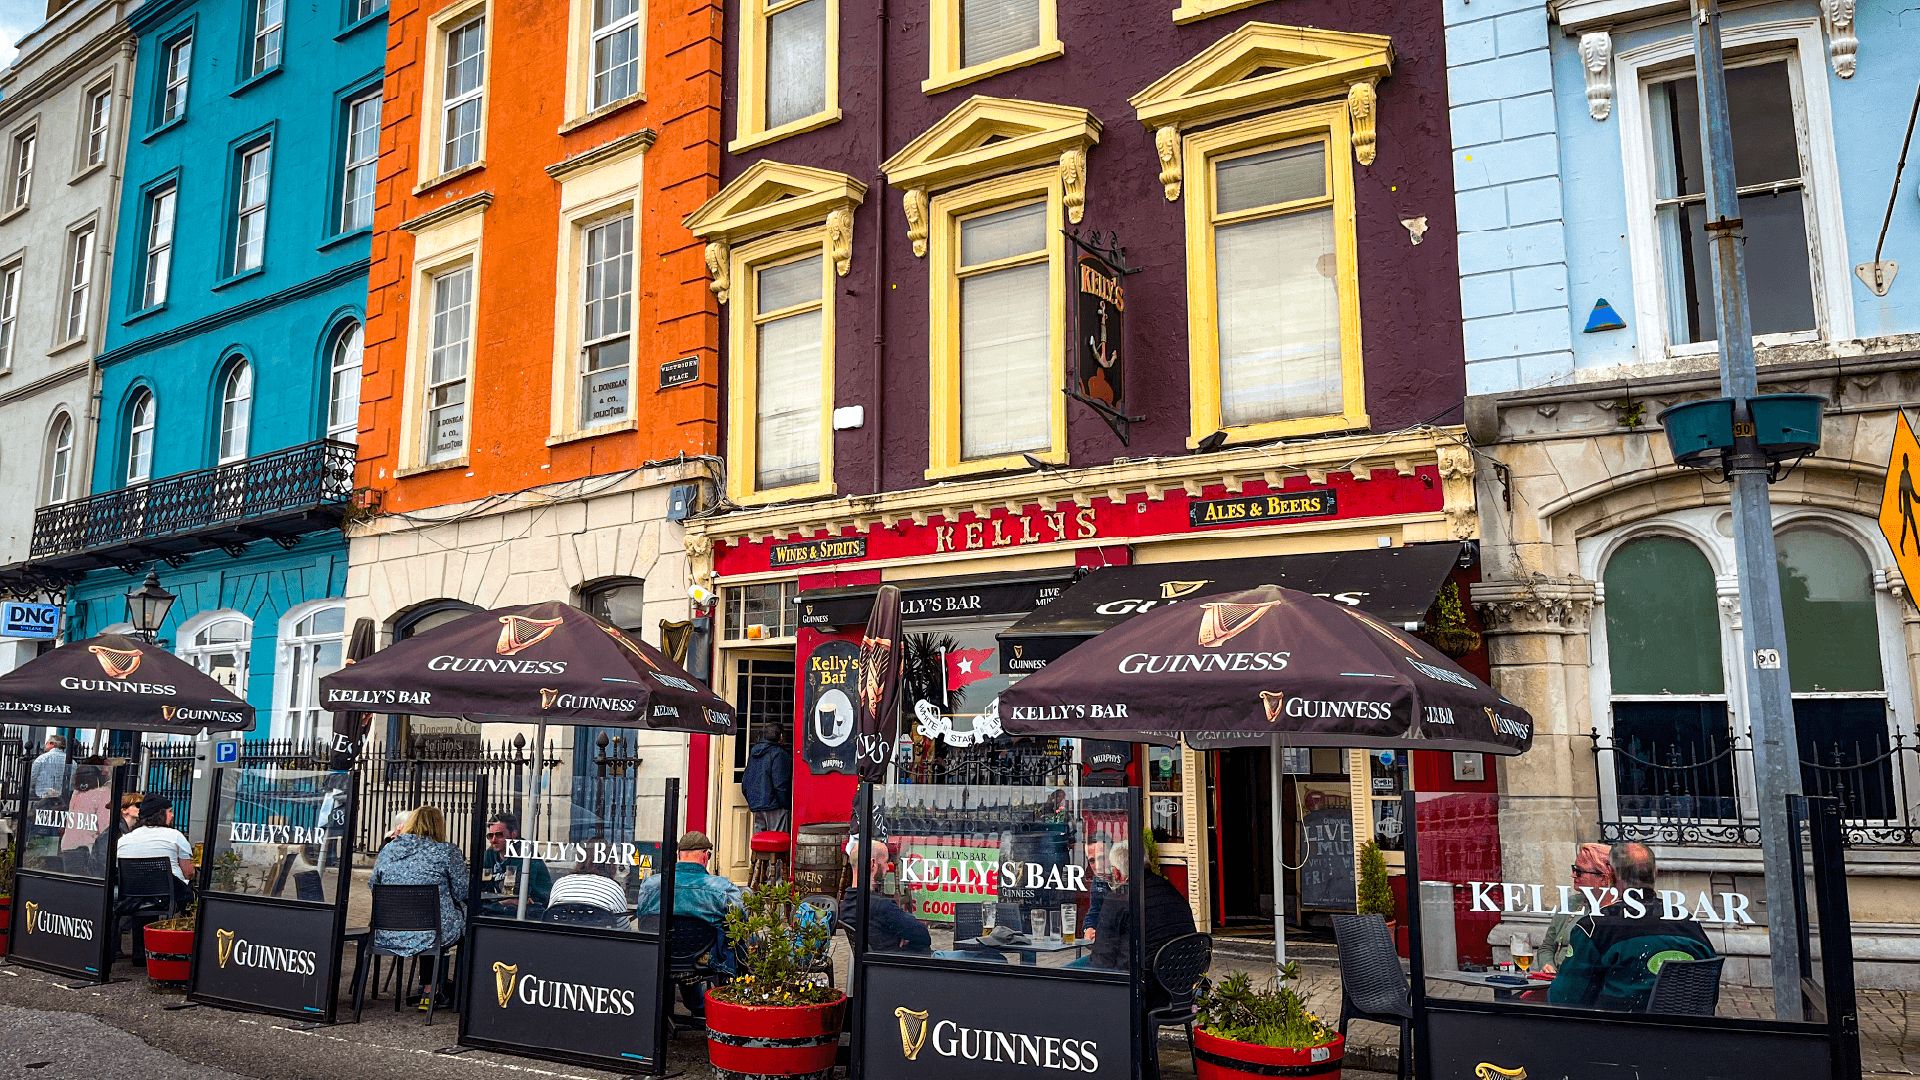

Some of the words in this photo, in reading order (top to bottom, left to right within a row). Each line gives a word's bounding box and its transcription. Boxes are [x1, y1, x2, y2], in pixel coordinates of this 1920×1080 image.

[1081, 263, 1124, 311] KELLY'S
[598, 379, 627, 392] DONEGAN
[668, 373, 689, 382] PLACE
[593, 406, 624, 419] SOLICITORS
[1736, 424, 1750, 435] 90
[1204, 504, 1246, 521] ALES
[1249, 504, 1263, 517] &
[1267, 496, 1321, 515] BEERS
[776, 546, 808, 563] WINES
[809, 547, 817, 559] &
[820, 540, 860, 557] SPIRITS
[1039, 587, 1060, 597] LIVE
[901, 598, 942, 614] LLY'S
[946, 595, 981, 611] BAR
[10, 606, 54, 624] DNG
[802, 613, 828, 623] GUINNESS
[427, 655, 568, 675] GUINNESS
[812, 656, 859, 676] Kelly's
[1009, 658, 1047, 670] GUINNESS
[1118, 651, 1291, 674] GUINNESS
[1758, 653, 1776, 664] 90
[60, 677, 177, 696] GUINNESS
[820, 671, 847, 684] Bar
[328, 688, 396, 704] KELLY'S
[398, 691, 432, 706] BAR
[557, 693, 637, 712] GUINNESS
[0, 702, 41, 713] ELLY'S
[44, 704, 71, 714] BAR
[176, 707, 243, 723] GUINNESS
[918, 703, 938, 731] WHITE
[1011, 704, 1085, 720] KELLY'S
[1089, 703, 1129, 718] BAR
[1285, 697, 1392, 720] GUINNESS
[419, 723, 453, 736] Donegan
[455, 723, 463, 734] &
[464, 722, 479, 734] Co.
[989, 716, 1000, 729] LIN
[950, 734, 974, 743] STAR
[221, 744, 234, 760] P
[34, 809, 75, 829] KELLY'S
[76, 812, 98, 831] BAR
[229, 822, 290, 844] KELLY'S
[294, 826, 325, 844] BAR
[1304, 824, 1351, 842] LIVE
[504, 839, 587, 862] KELLY'S
[592, 842, 639, 866] BAR
[936, 850, 969, 861] KELLY'S
[969, 852, 987, 861] BAR
[1316, 841, 1353, 856] MUS
[795, 871, 823, 885] OWERS
[900, 857, 1016, 887] KELLY'S
[1026, 862, 1088, 892] BAR
[1002, 887, 1035, 898] GINNESS
[1467, 881, 1646, 920] KELLY'S
[1657, 889, 1756, 924] BAR
[37, 910, 93, 941] GUINNESS
[233, 939, 316, 976] GUINNESS
[519, 974, 635, 1016] GUINNESS
[931, 1019, 1099, 1073] GUINNESS
